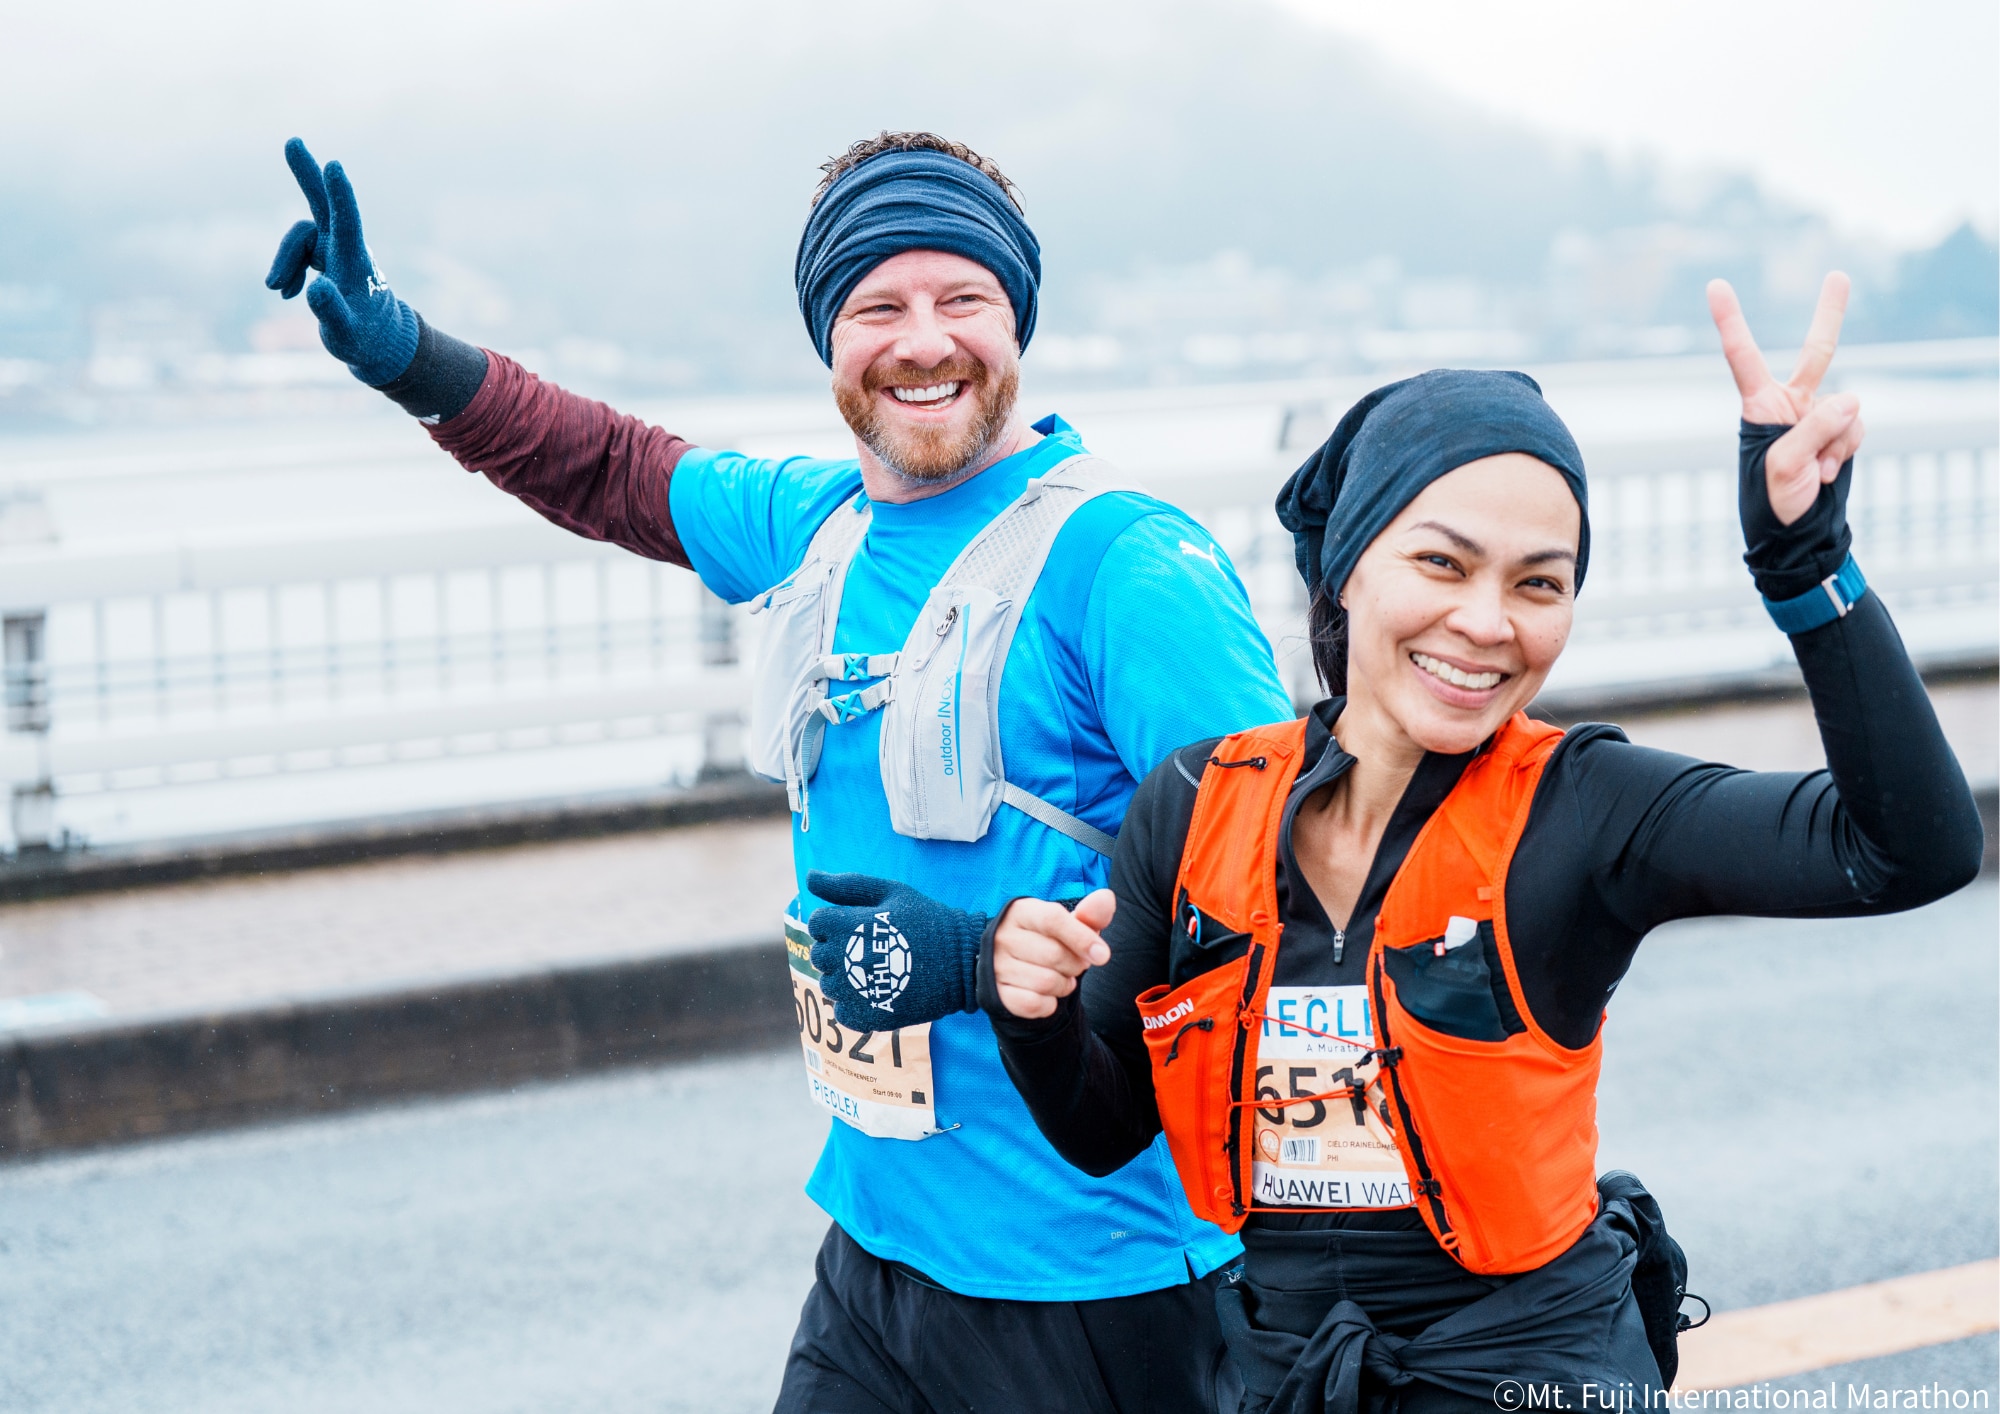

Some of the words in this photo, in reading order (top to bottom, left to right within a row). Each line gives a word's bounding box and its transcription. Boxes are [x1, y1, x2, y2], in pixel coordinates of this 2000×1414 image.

[940, 723, 954, 776] outdoor
[873, 911, 894, 1012] ATHLETA
[1306, 1044, 1313, 1052] A
[1318, 1044, 1359, 1053] Murata
[813, 1079, 860, 1119] PIECLEX
[872, 1088, 886, 1097] Start
[1327, 1140, 1348, 1148] CIELO
[1327, 1154, 1339, 1162] PHI
[1262, 1173, 1351, 1204] HUAWEI
